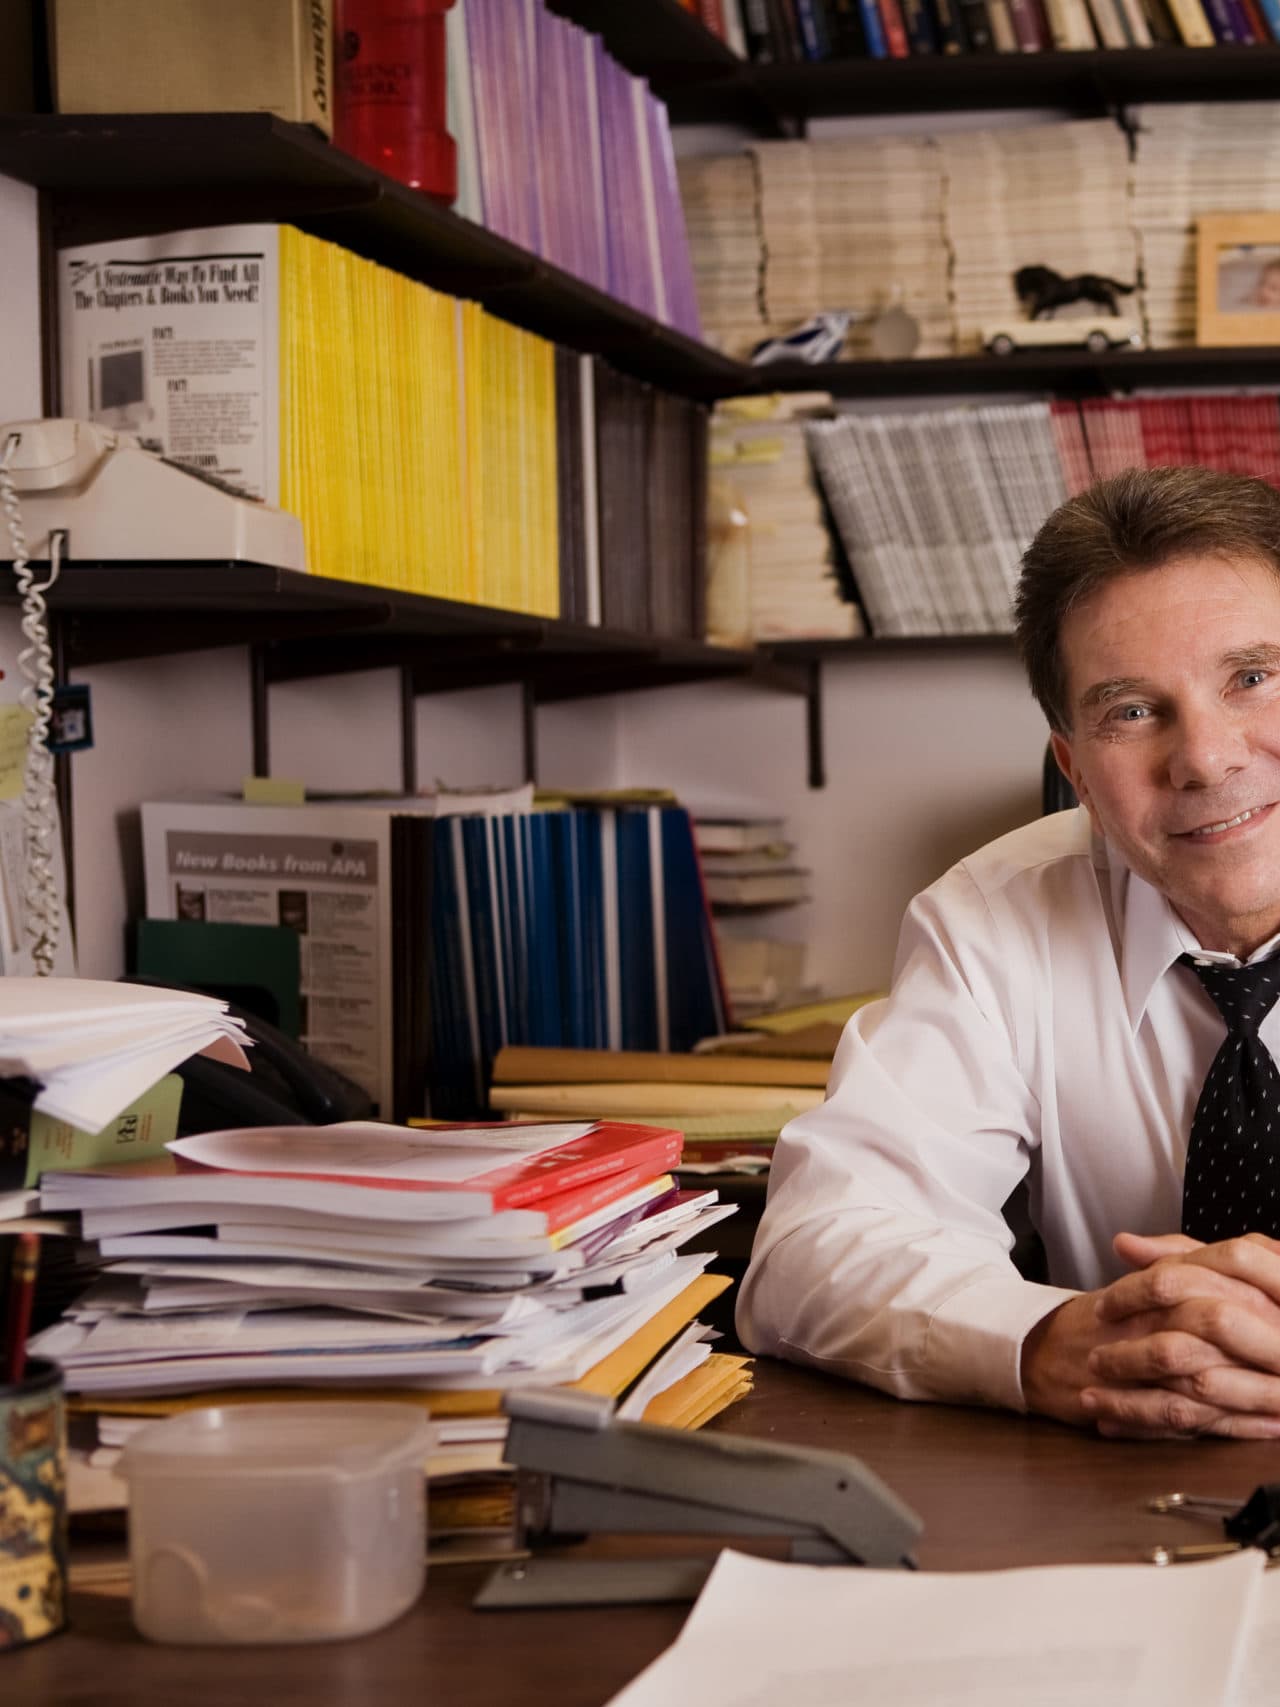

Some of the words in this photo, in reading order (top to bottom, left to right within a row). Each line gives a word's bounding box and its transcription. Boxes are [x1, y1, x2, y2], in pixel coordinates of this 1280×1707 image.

[104, 268, 161, 288] Systematic
[165, 266, 188, 285] Way
[192, 264, 206, 283] To
[209, 263, 238, 283] Find
[243, 263, 260, 282] All
[75, 291, 93, 309] The
[97, 287, 142, 311] Chapters
[146, 287, 156, 305] &
[160, 285, 194, 304] Books
[197, 285, 219, 303] You
[175, 851, 218, 868] New
[222, 853, 279, 872] Books
[284, 855, 327, 873] from
[331, 859, 367, 877] APA
